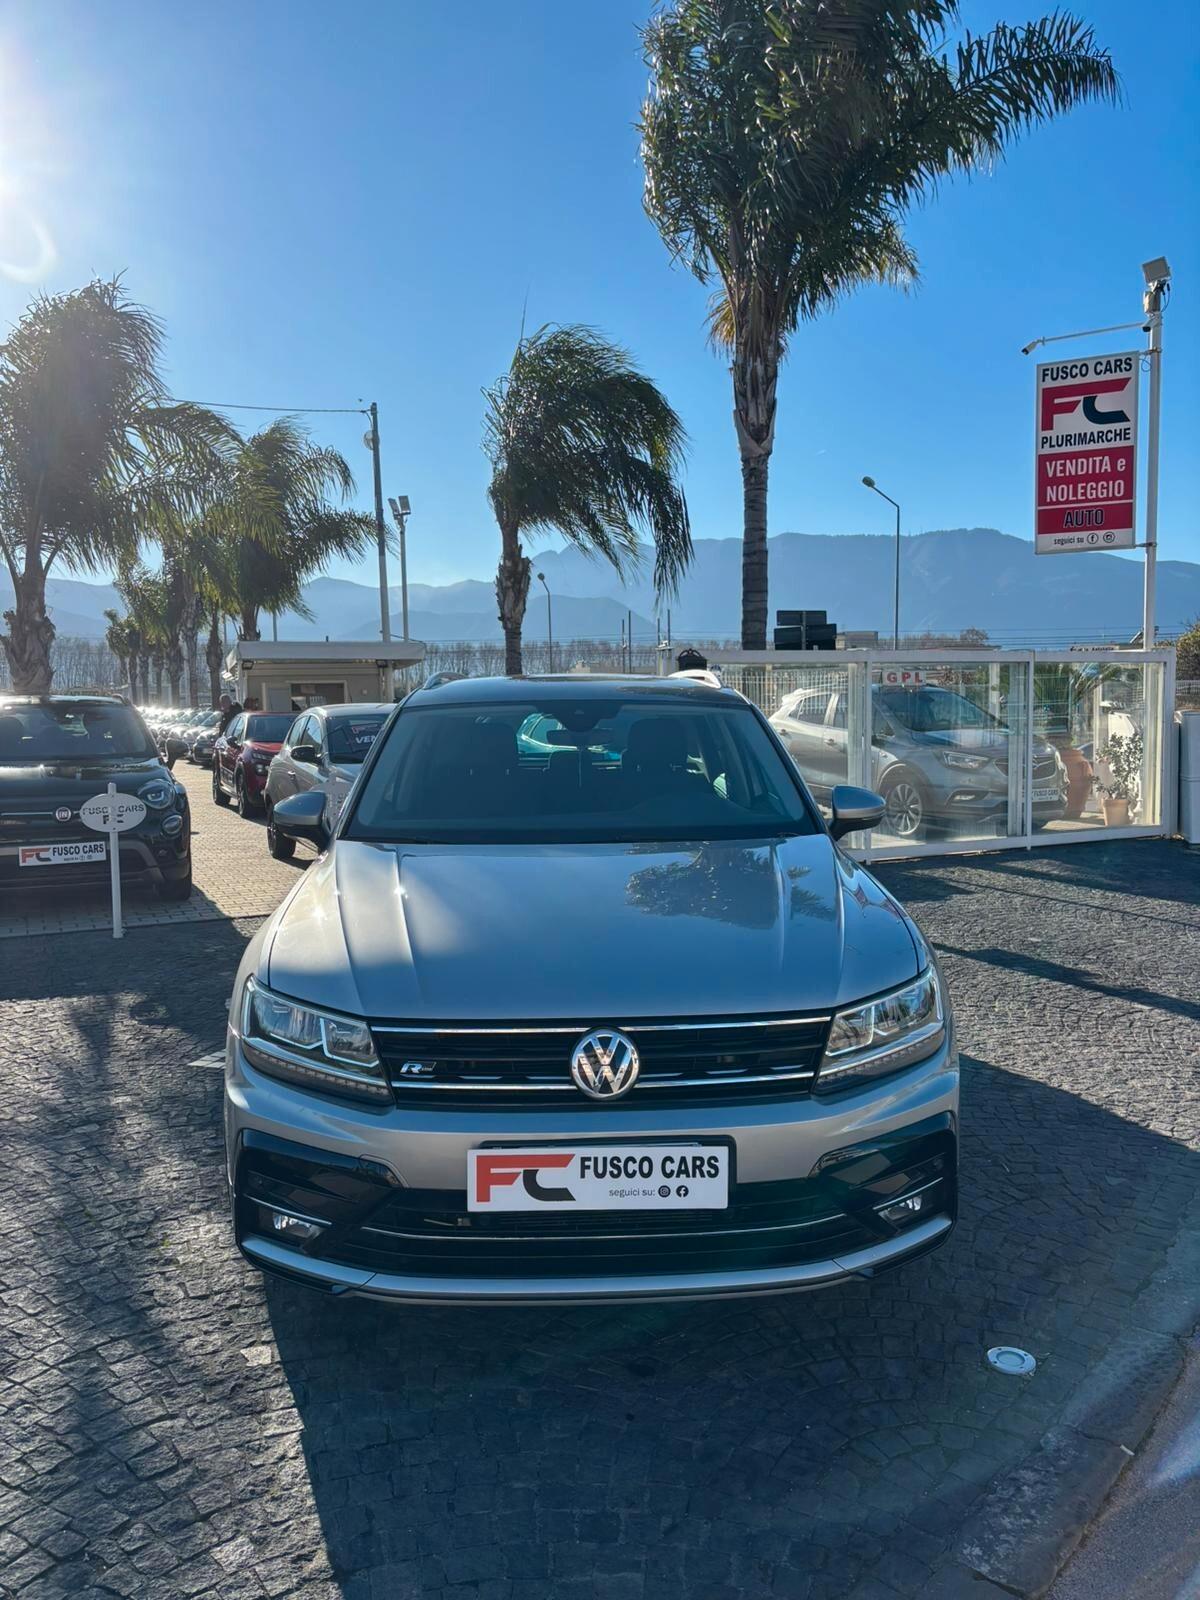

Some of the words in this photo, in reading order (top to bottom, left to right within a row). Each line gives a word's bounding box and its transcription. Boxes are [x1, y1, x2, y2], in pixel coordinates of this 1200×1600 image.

[1042, 363, 1089, 382] FUSCO
[1094, 357, 1133, 376] CARS
[1041, 428, 1131, 449] PLURIMARCHE
[1046, 456, 1111, 478] VENDITA
[1117, 458, 1126, 472] e
[1046, 480, 1125, 503] NOLEGGIO
[1063, 509, 1105, 528] AUTO
[887, 672, 923, 683] GPL
[118, 804, 145, 813] CARS
[52, 846, 80, 856] FUSCO
[82, 844, 104, 854] CARS
[580, 1156, 654, 1178] FUSCO
[661, 1155, 719, 1178] CARS
[609, 1188, 640, 1200] seguici
[642, 1187, 655, 1196] su:
